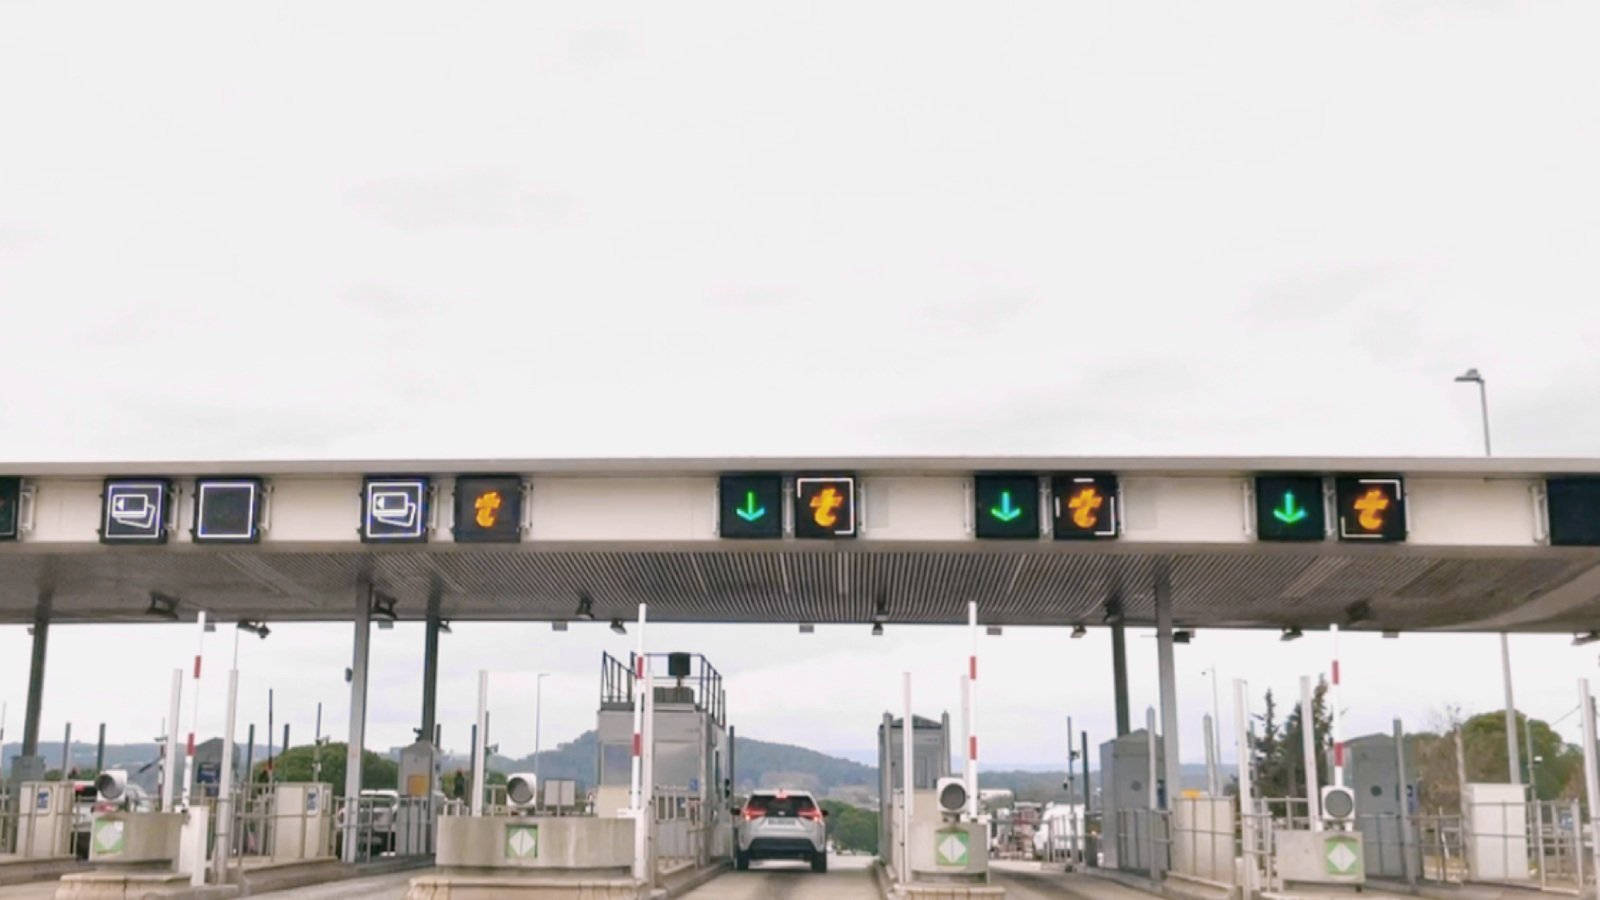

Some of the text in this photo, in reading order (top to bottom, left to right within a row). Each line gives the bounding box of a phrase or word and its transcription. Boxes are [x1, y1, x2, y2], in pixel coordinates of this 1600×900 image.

[474, 491, 502, 528] t
[809, 487, 844, 527] t
[1068, 487, 1104, 528] t
[1353, 490, 1389, 531] t
